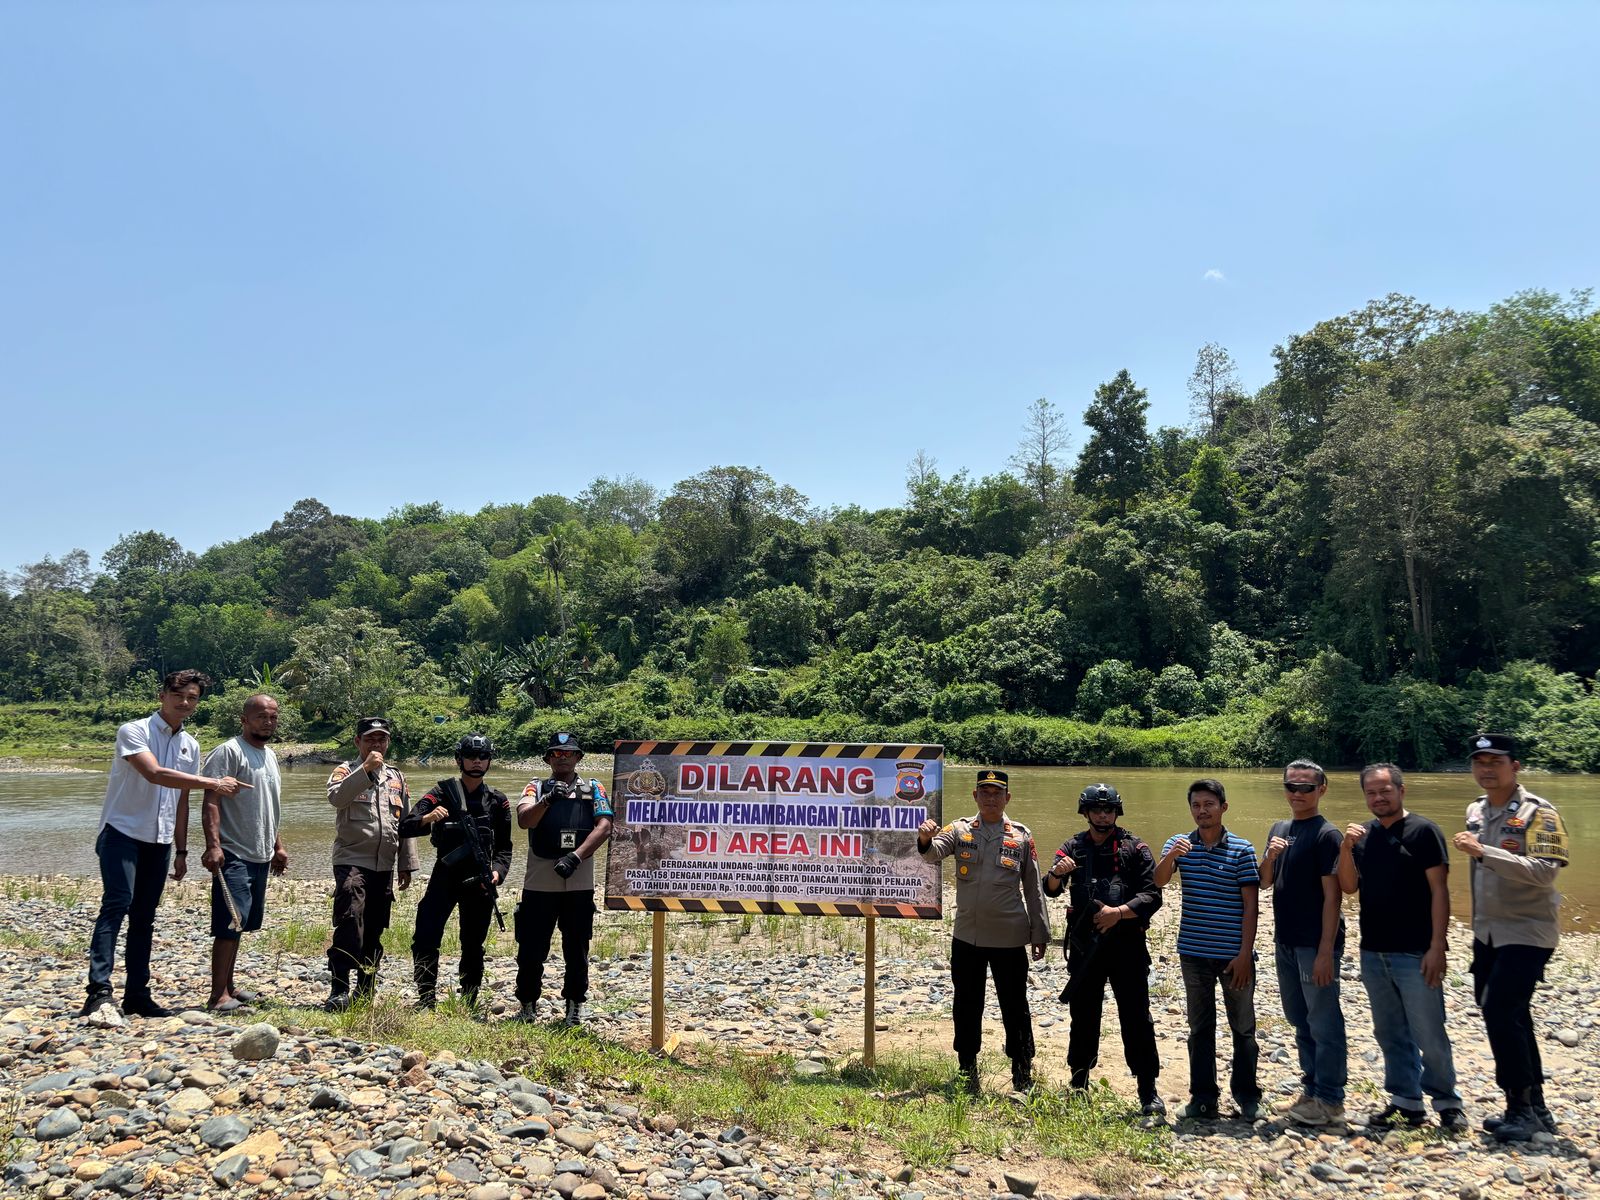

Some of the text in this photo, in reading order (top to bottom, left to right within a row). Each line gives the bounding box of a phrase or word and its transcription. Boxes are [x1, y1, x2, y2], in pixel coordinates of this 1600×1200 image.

[680, 764, 874, 795] DILARANG
[628, 801, 925, 830] MELAKUKAN PENAMBANGAN TANPA IZIN
[688, 831, 861, 857] DI AREA INI
[661, 860, 886, 874] BERDASARKAN UNDANG-UNDANG NOMOR 04 TAHUN 2009
[626, 870, 922, 887] PASAL 158 DENGAN PIDANA PENJARA SERTA DIANCAM HUKUMAN PENJARA
[632, 881, 641, 890] 10
[644, 882, 670, 890] TAHUN
[672, 882, 688, 890] DAN
[690, 883, 717, 892] DENDA
[720, 884, 732, 893] Rp.
[806, 886, 846, 896] (SEPULUH
[848, 887, 877, 896] MILIAR
[880, 888, 910, 898] RUPIAH
